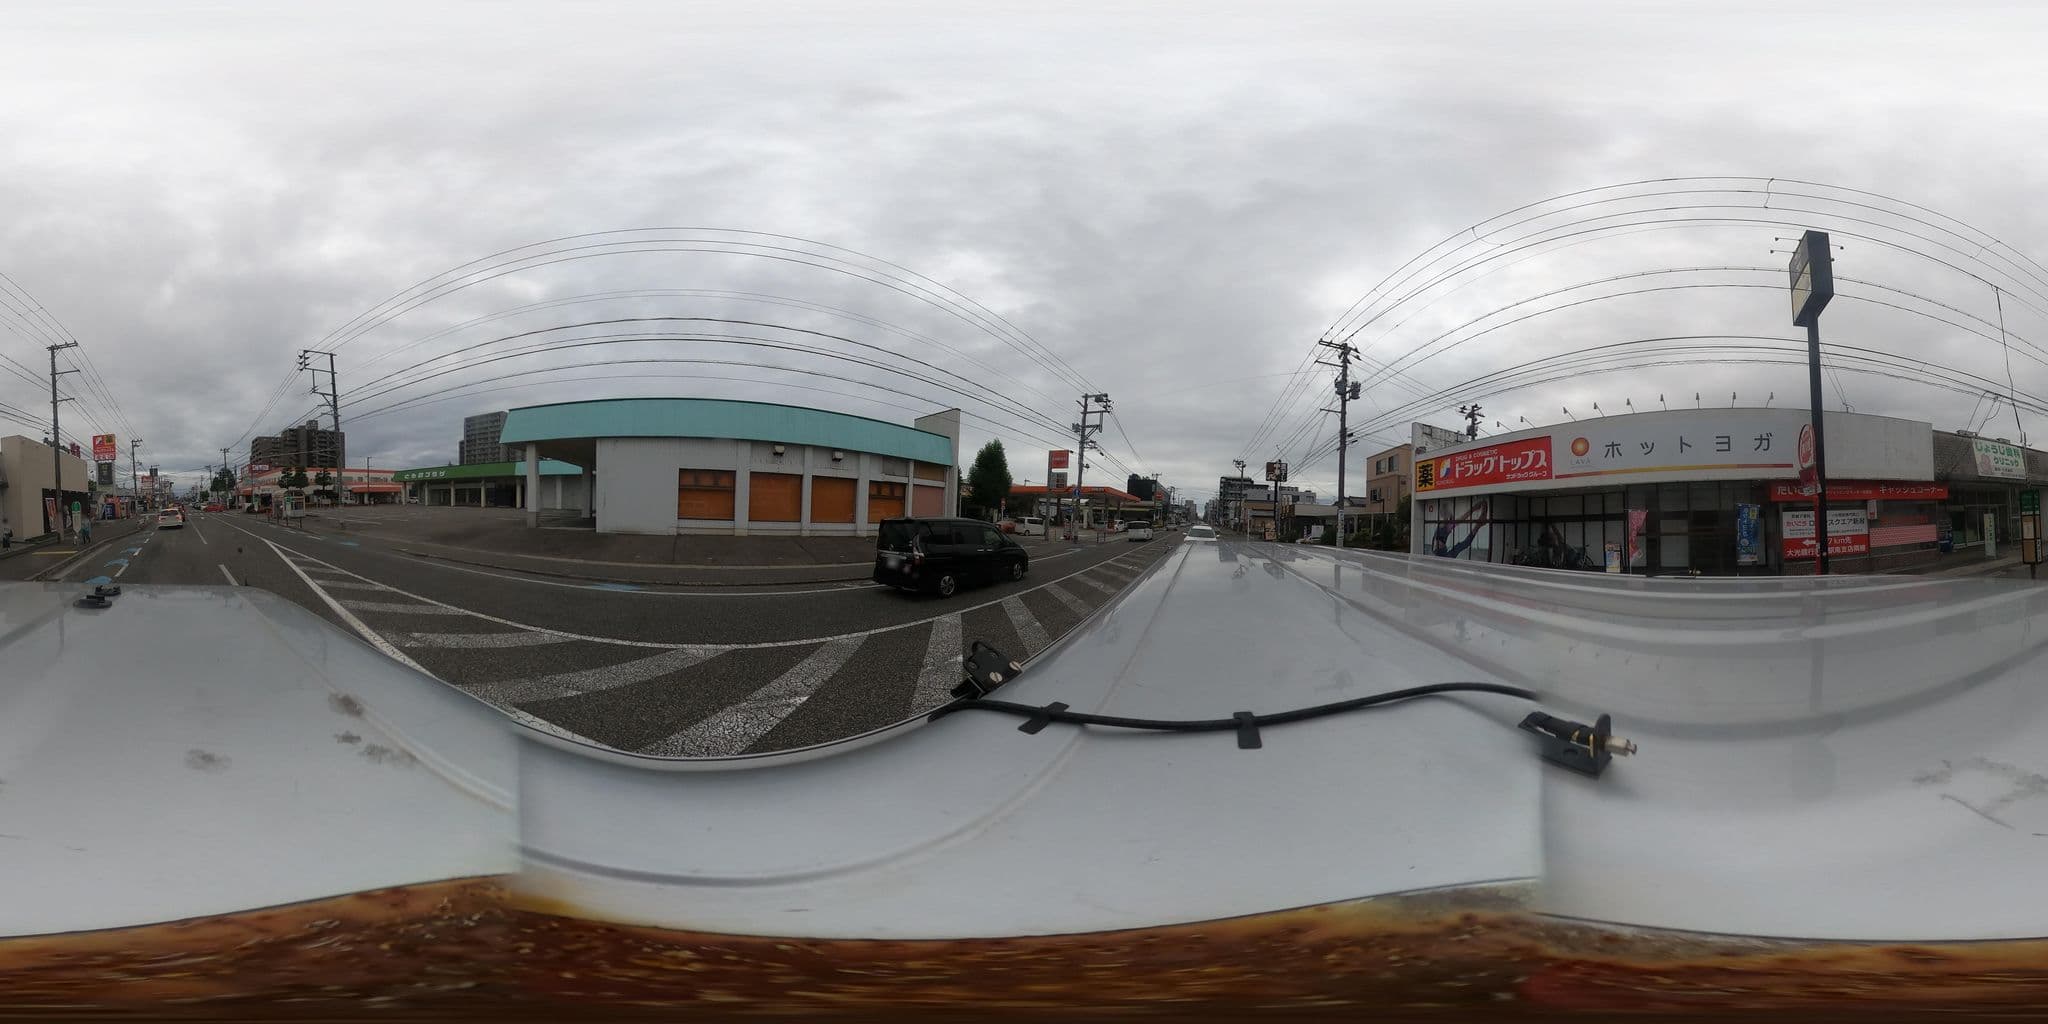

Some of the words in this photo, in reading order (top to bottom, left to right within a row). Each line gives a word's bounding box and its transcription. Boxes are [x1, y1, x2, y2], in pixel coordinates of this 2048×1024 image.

[1604, 432, 1773, 459] ホットヨガ
[1418, 463, 1434, 488] 薬
